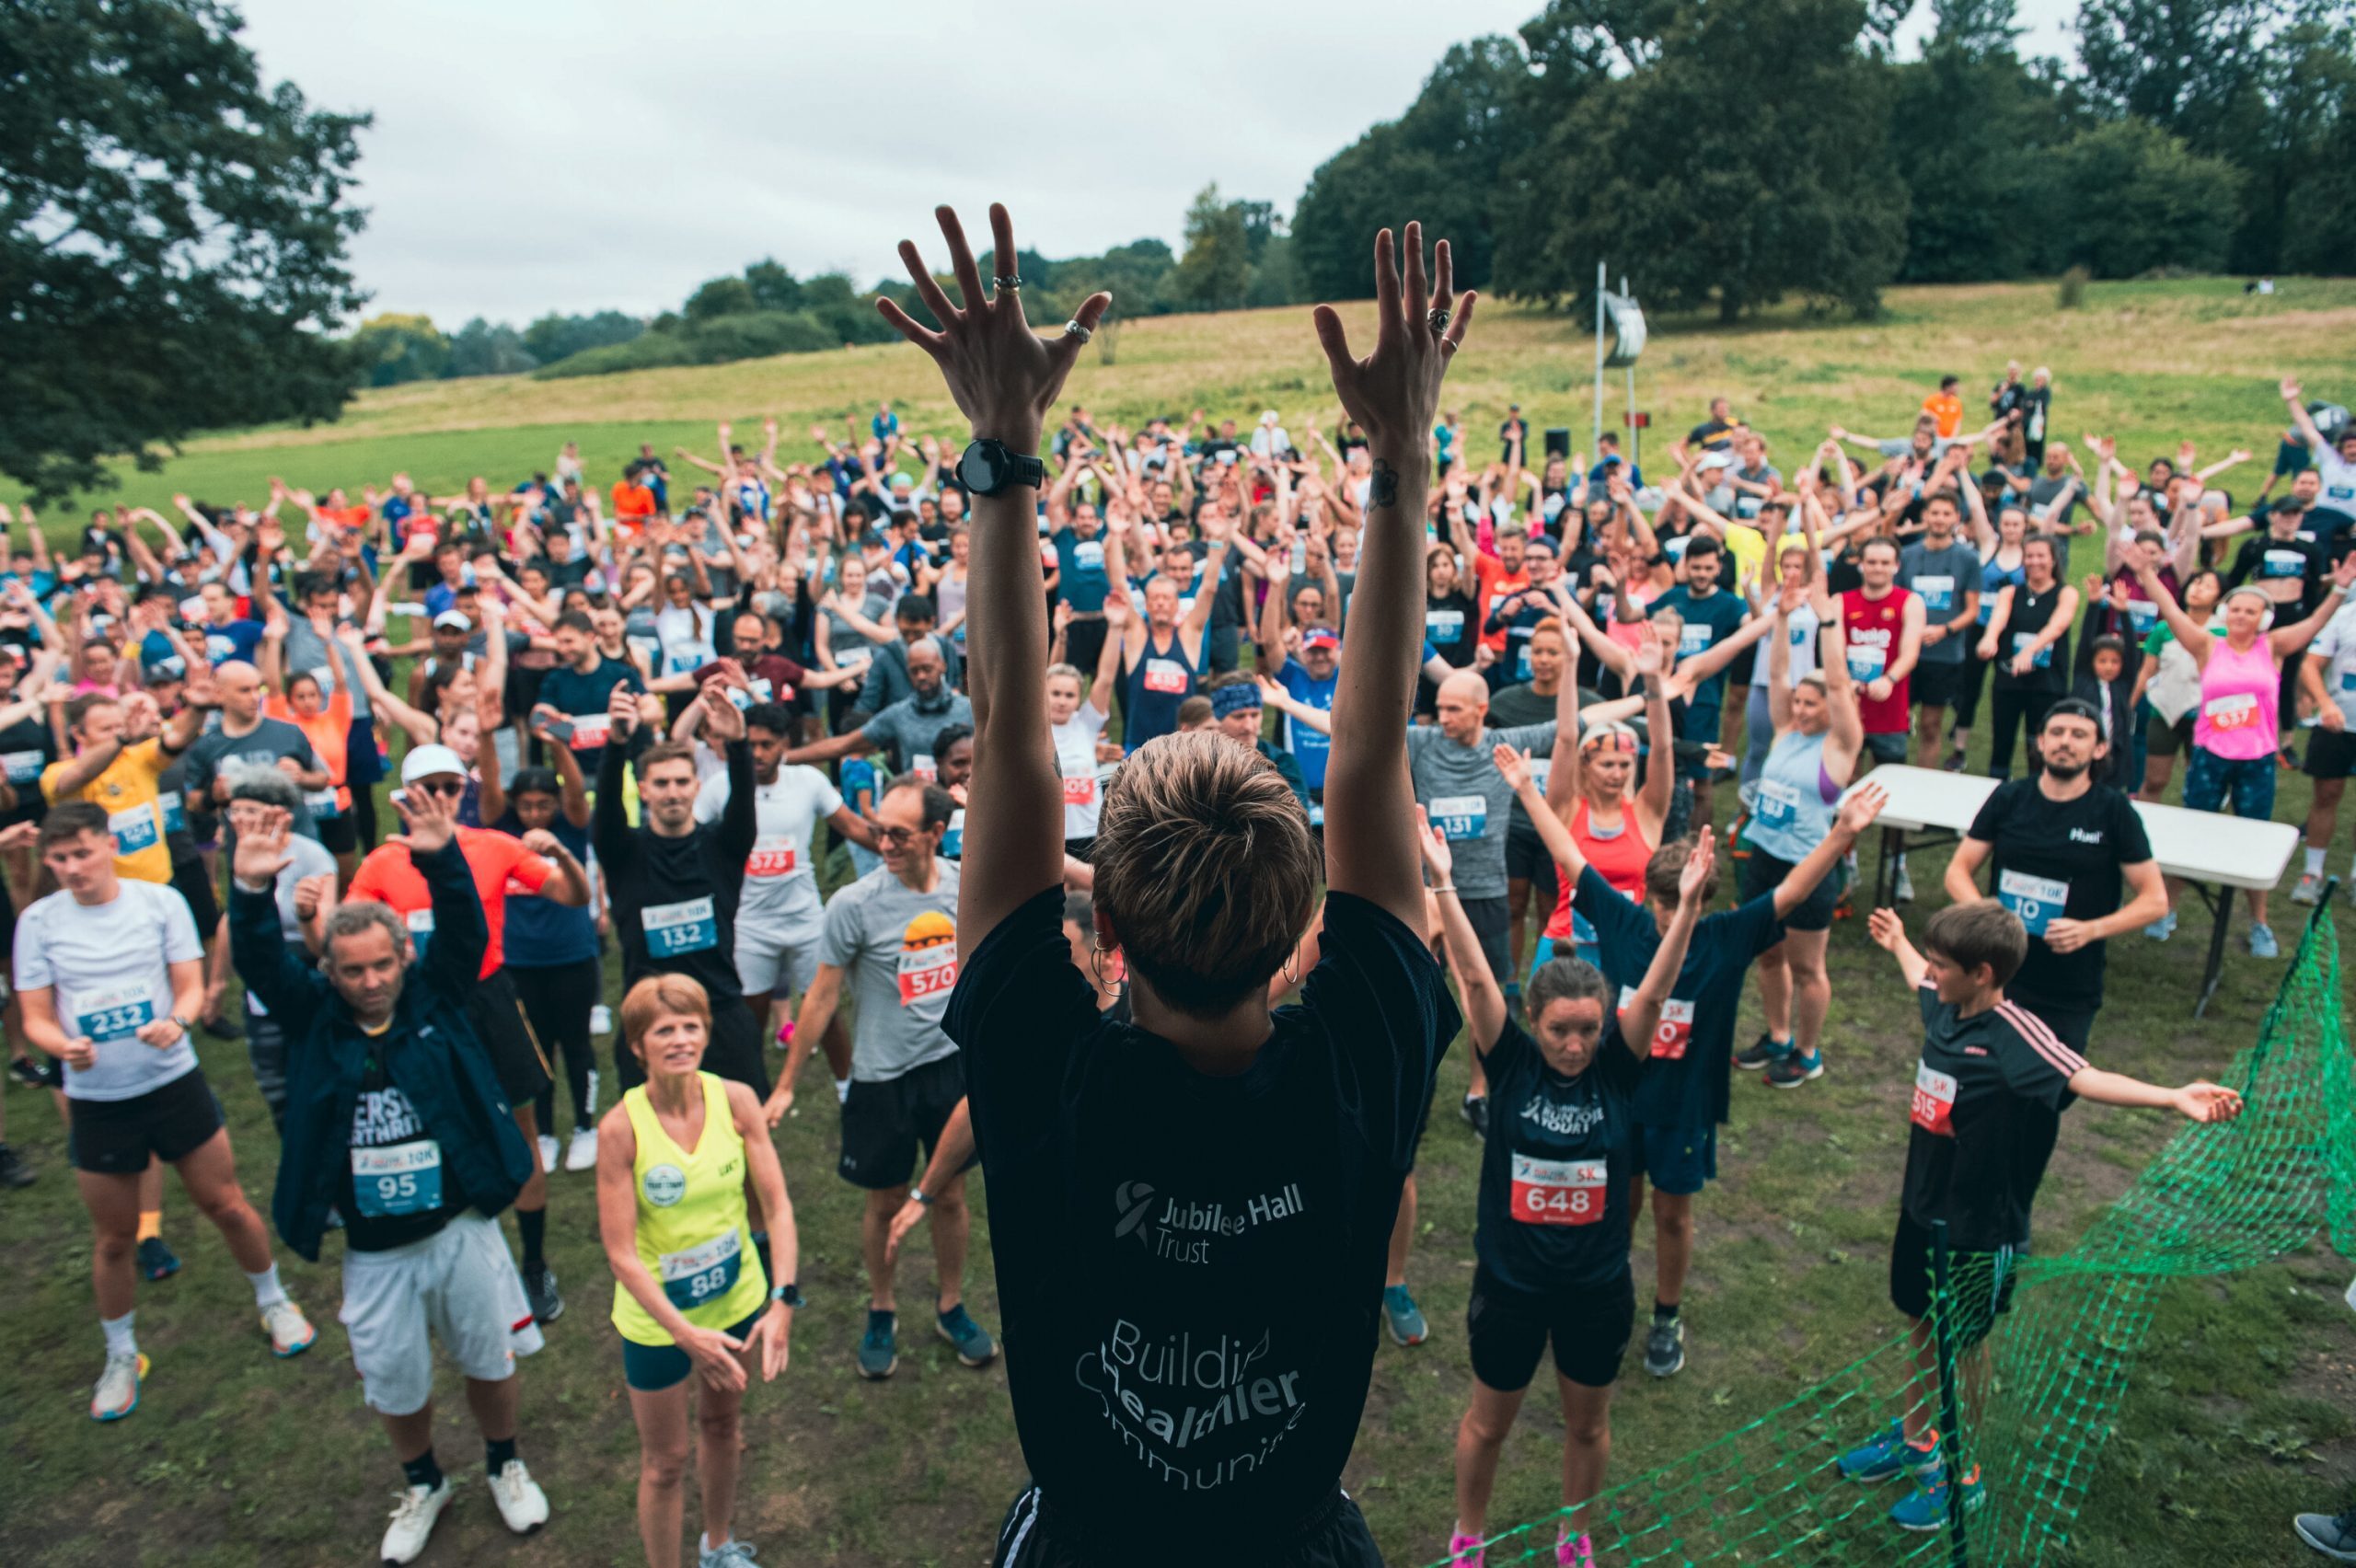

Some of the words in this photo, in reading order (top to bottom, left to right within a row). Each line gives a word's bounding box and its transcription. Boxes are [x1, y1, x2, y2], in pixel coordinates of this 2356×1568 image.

[1443, 816, 1472, 833] 131
[749, 852, 787, 870] 573
[660, 924, 703, 948] 132
[911, 965, 956, 994] 570
[90, 1005, 146, 1034] 232
[376, 1173, 418, 1200] 95
[1576, 1167, 1597, 1182] 5K
[1159, 1197, 1245, 1237] Jubilee
[1247, 1182, 1304, 1226] Hall
[1526, 1187, 1590, 1214] 648
[1156, 1226, 1210, 1264] Trust
[691, 1266, 726, 1297] 88
